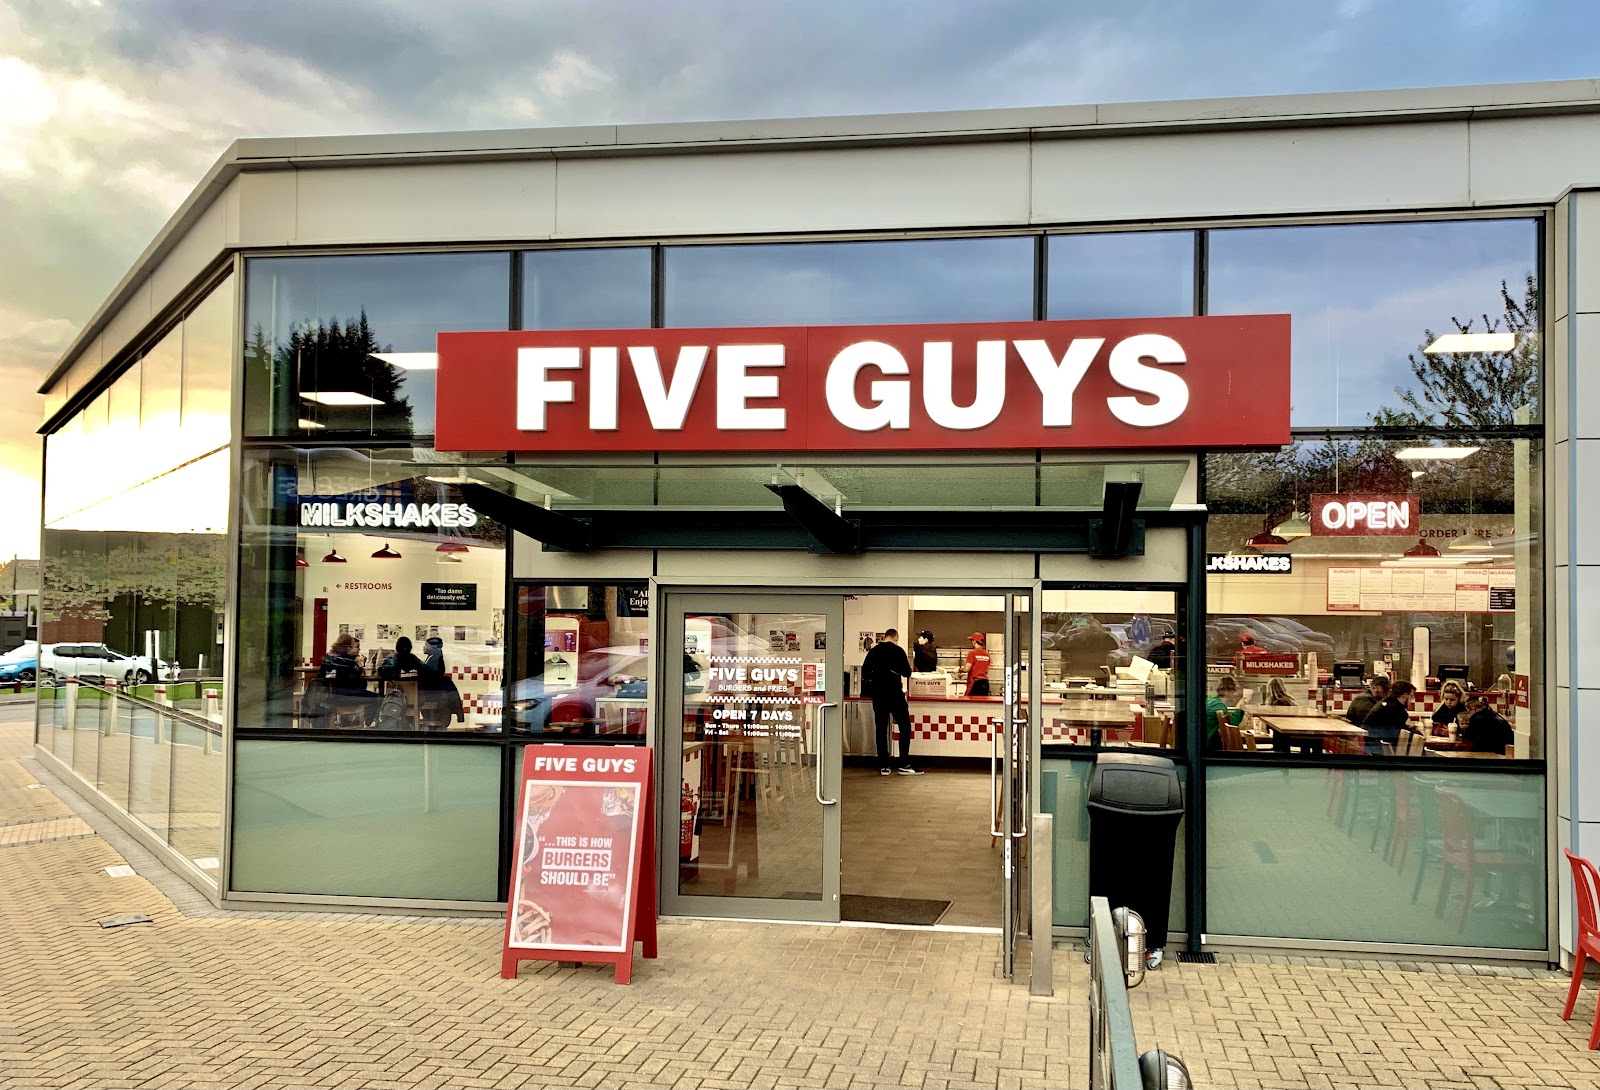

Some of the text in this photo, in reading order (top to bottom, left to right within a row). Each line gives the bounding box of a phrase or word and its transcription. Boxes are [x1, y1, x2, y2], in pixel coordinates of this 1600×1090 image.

[515, 333, 1190, 432] FIVE GUYS
[300, 503, 478, 527] MILKSHAKES
[1321, 501, 1410, 529] OPEN
[1420, 529, 1458, 538] ORDER
[344, 582, 393, 590] RESTROOMS
[629, 597, 649, 607] Enjo
[1245, 661, 1295, 669] MILKSHAKES
[708, 667, 748, 681] FIVE
[750, 668, 799, 682] GUYS
[718, 684, 752, 692] BURGERS
[767, 685, 788, 693] FRIES
[803, 696, 822, 704] PULL
[712, 709, 794, 721] OPEN 7 DAYS
[721, 722, 740, 730] Thurs
[534, 757, 637, 773] FIVE GUYS
[579, 837, 588, 847] IS
[590, 838, 613, 848] HOW
[544, 851, 610, 868] BURGERS
[540, 871, 590, 885] SHOULD
